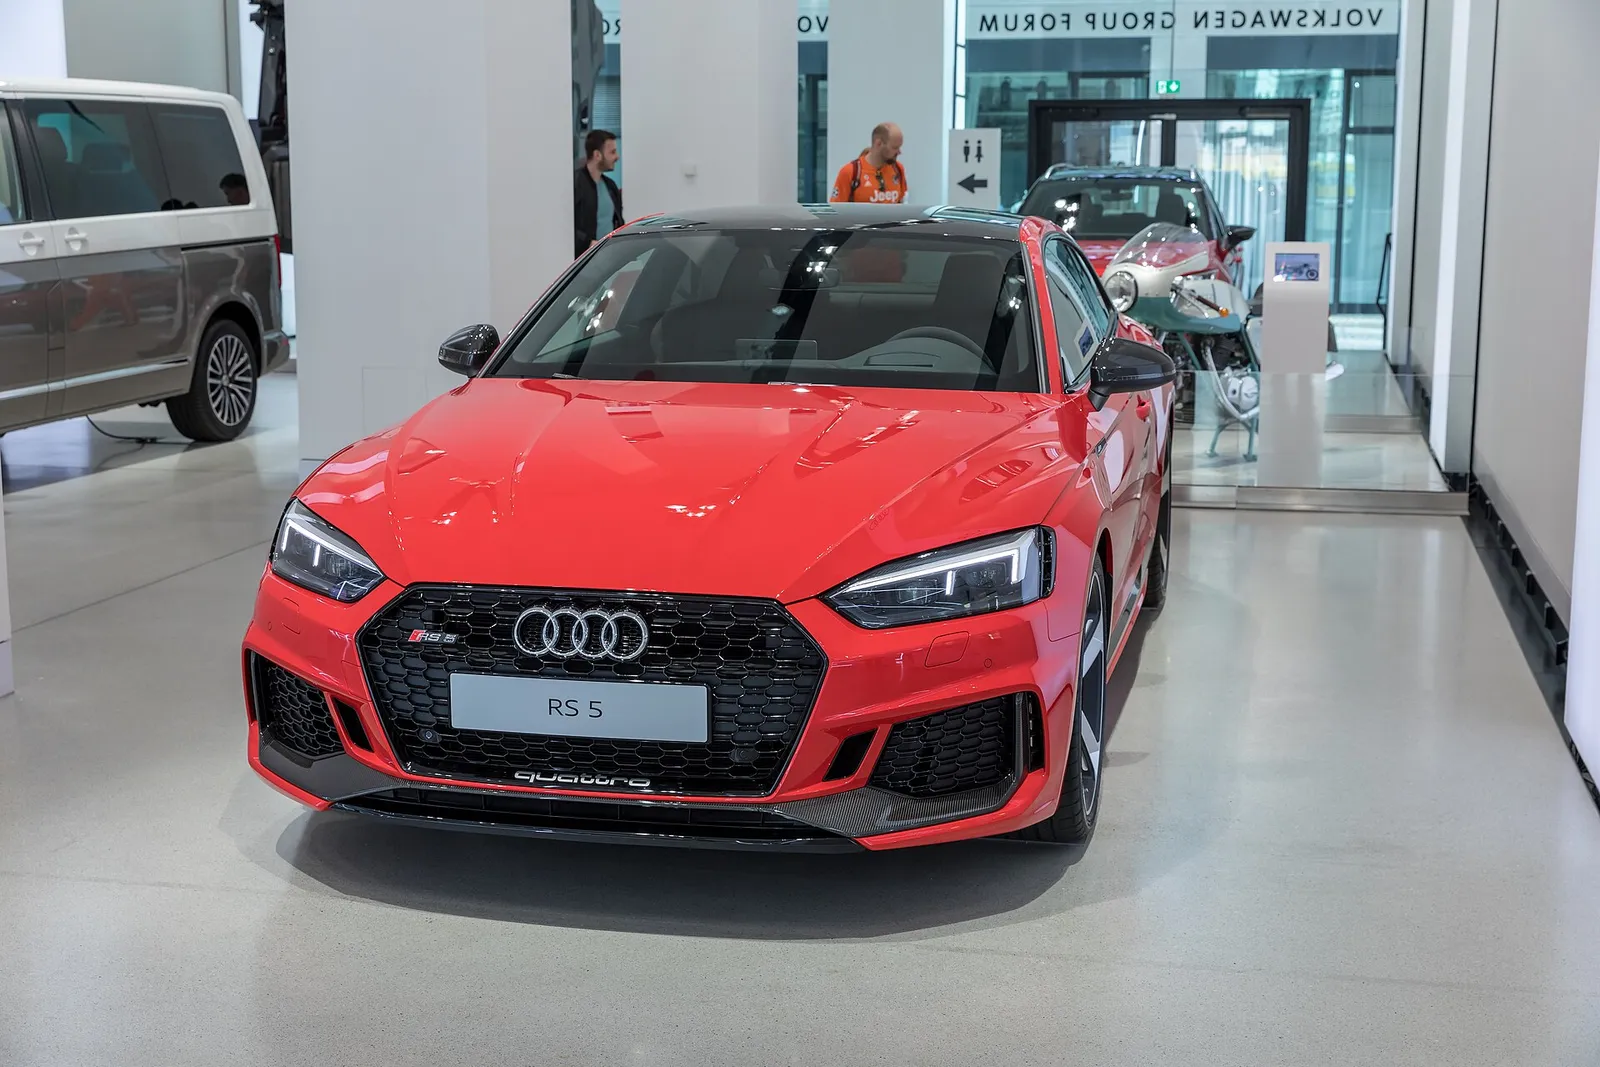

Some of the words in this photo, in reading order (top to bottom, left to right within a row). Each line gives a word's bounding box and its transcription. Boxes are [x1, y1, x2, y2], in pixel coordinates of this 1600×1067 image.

[869, 189, 899, 203] Jeep
[548, 698, 579, 717] RS
[588, 700, 603, 719] 5
[514, 770, 651, 787] quattro
